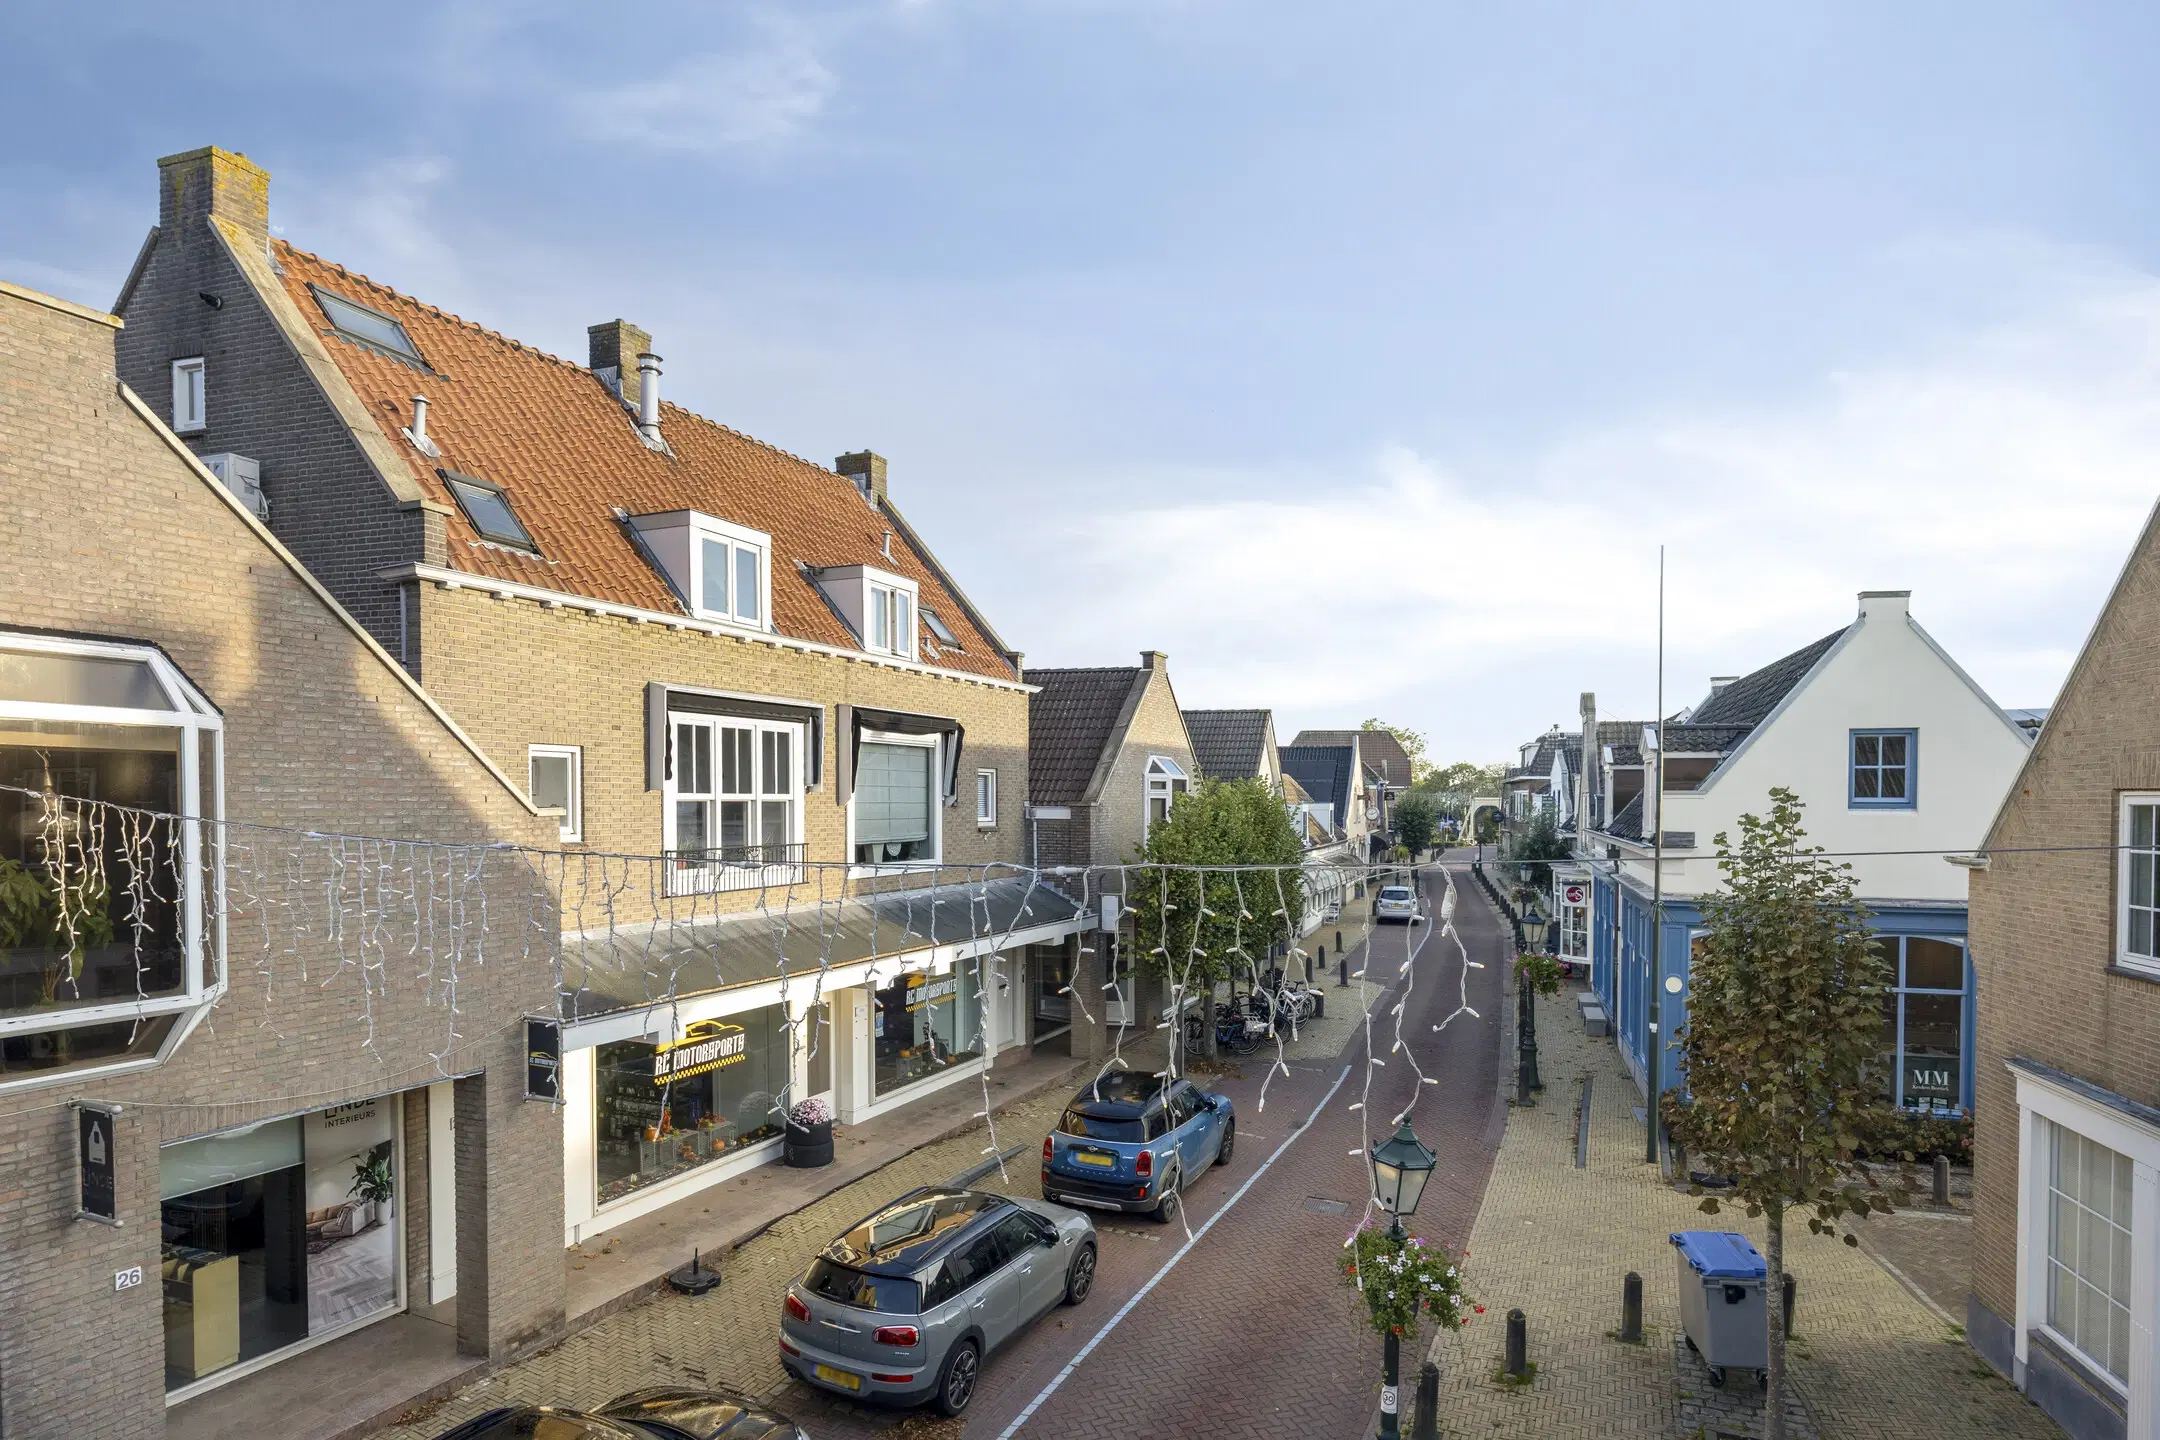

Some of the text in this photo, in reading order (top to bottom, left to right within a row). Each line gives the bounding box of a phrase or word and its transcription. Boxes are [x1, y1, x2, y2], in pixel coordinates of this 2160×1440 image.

[654, 1033, 745, 1077] RC MOTORSPORTS
[1913, 1069, 1949, 1086] MM
[324, 1109, 376, 1129] INTERIEURS
[118, 1269, 140, 1289] 26
